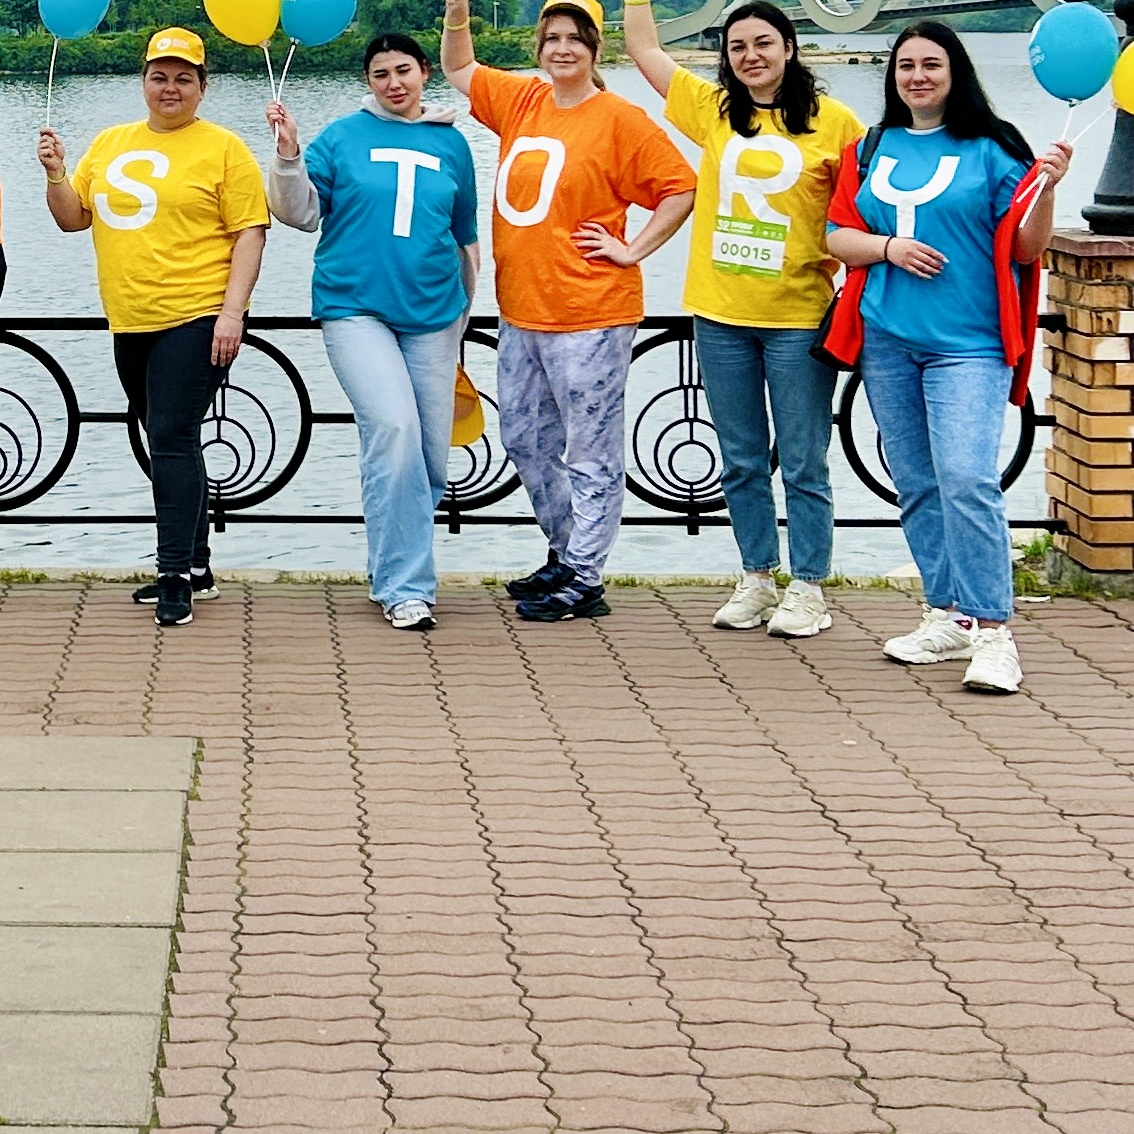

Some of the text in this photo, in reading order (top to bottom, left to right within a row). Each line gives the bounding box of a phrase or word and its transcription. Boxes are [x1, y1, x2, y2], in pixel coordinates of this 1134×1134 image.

[94, 150, 170, 230] S
[370, 148, 441, 238] T
[496, 135, 566, 227] O
[718, 134, 804, 232] R
[870, 155, 961, 239] Y
[720, 241, 771, 261] 00015
